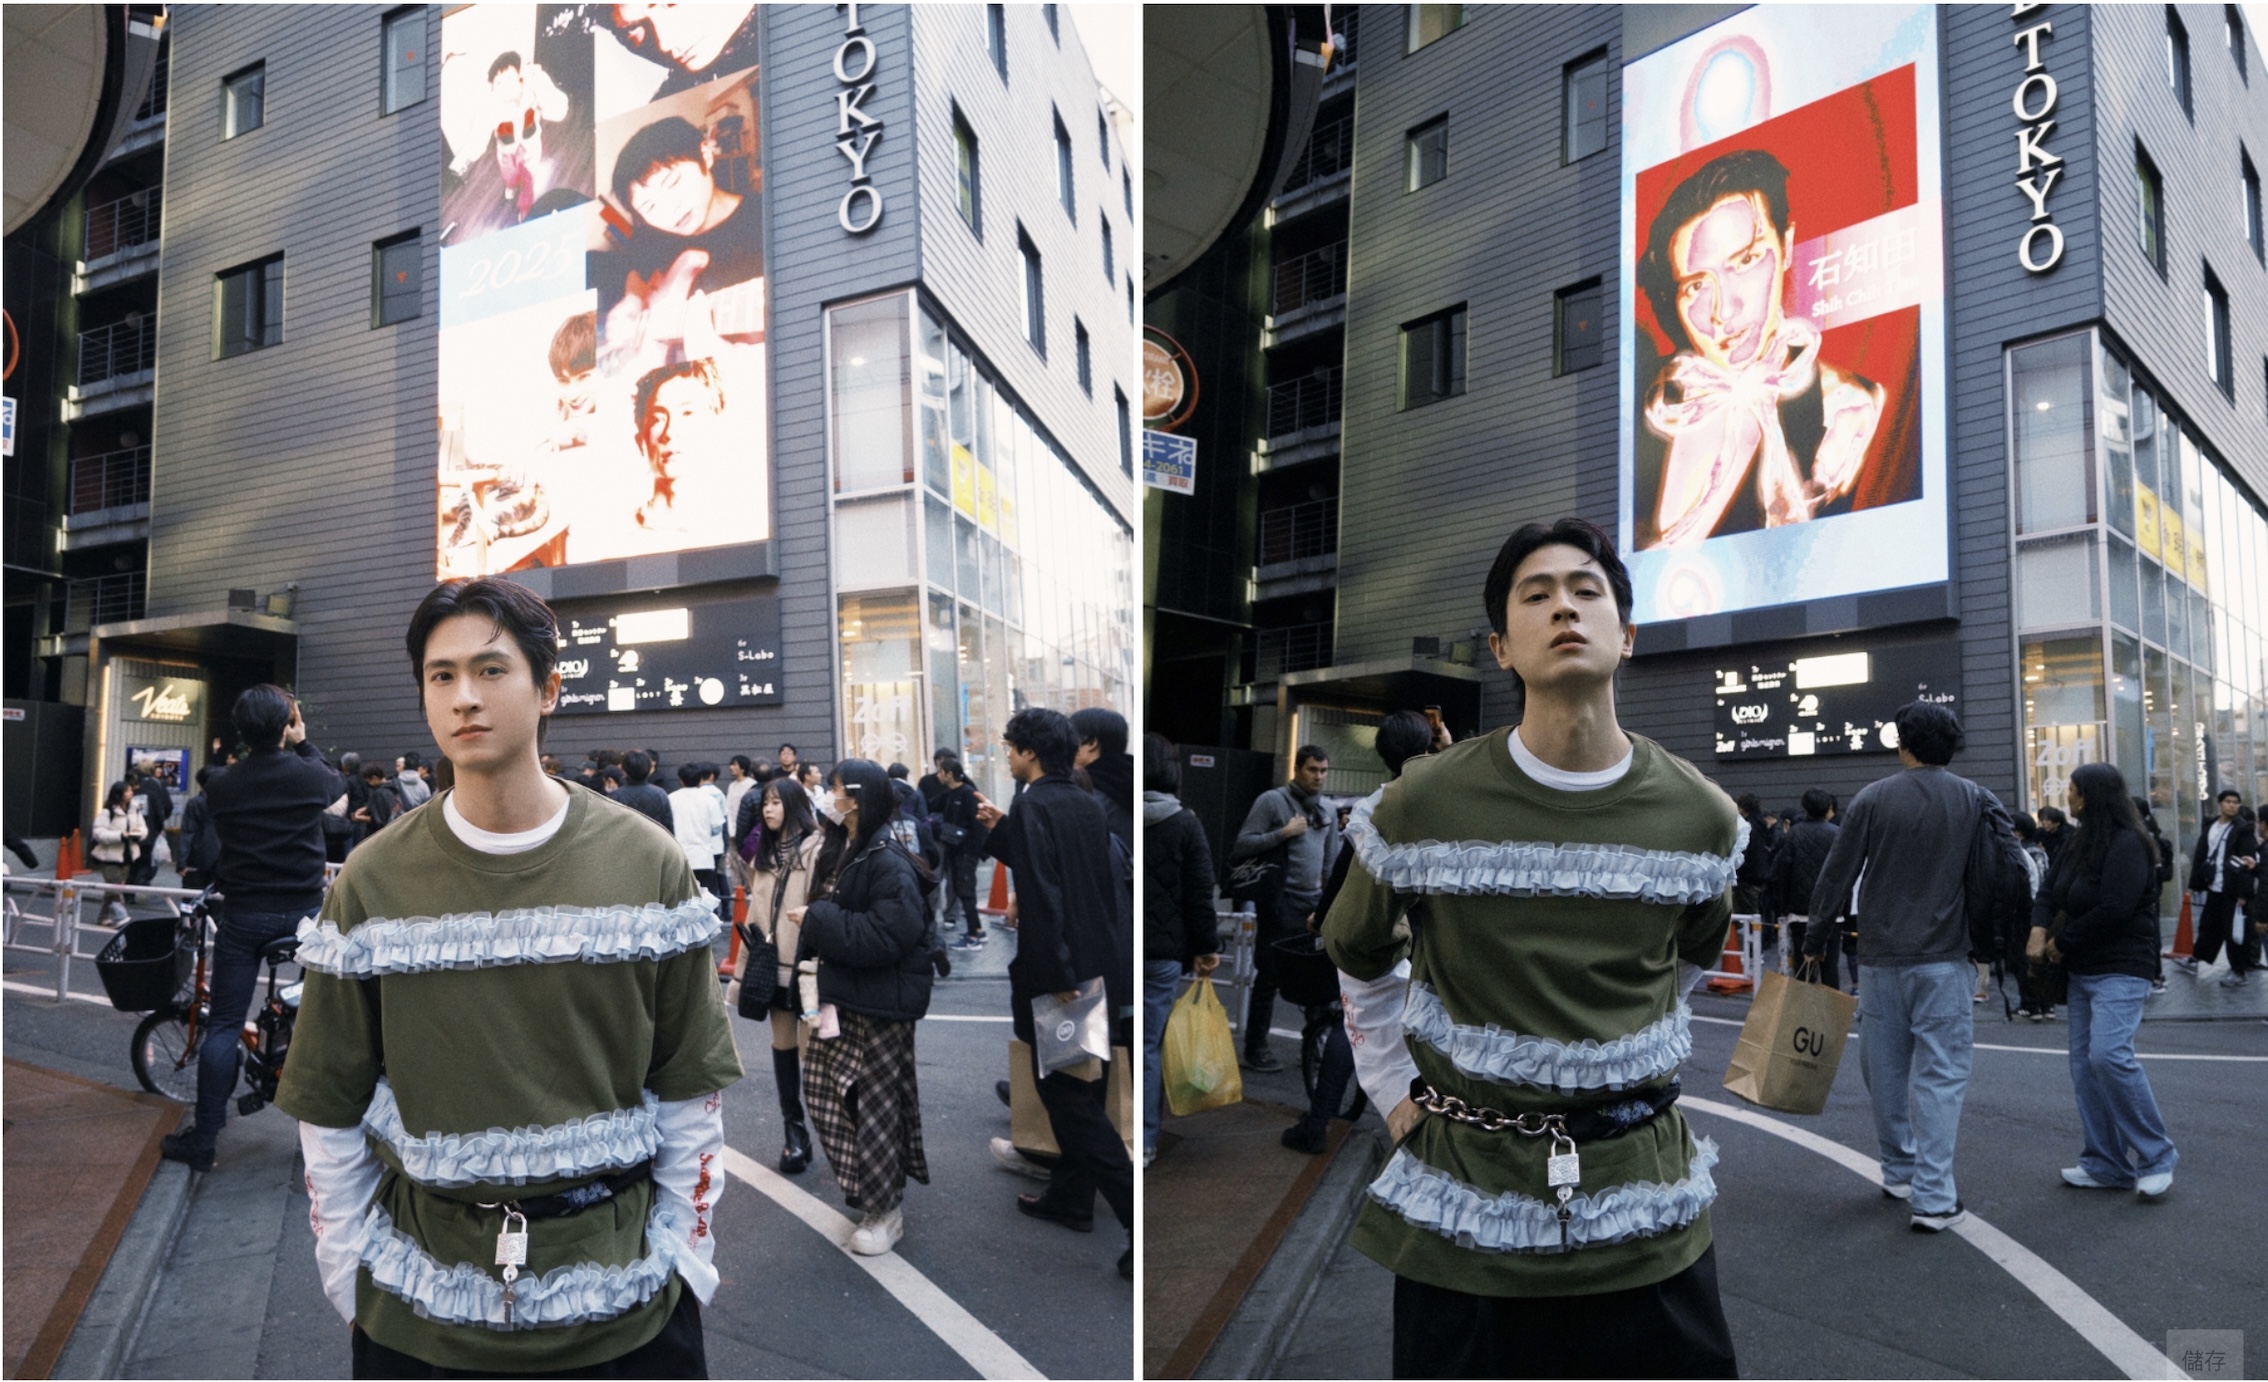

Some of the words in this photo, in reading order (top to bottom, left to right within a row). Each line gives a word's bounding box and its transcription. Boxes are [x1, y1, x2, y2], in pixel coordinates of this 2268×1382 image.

[2012, 22, 2064, 272] TOKYO
[456, 229, 582, 300] 2025
[1811, 295, 1843, 318] Shih
[1793, 1026, 1825, 1057] GU
